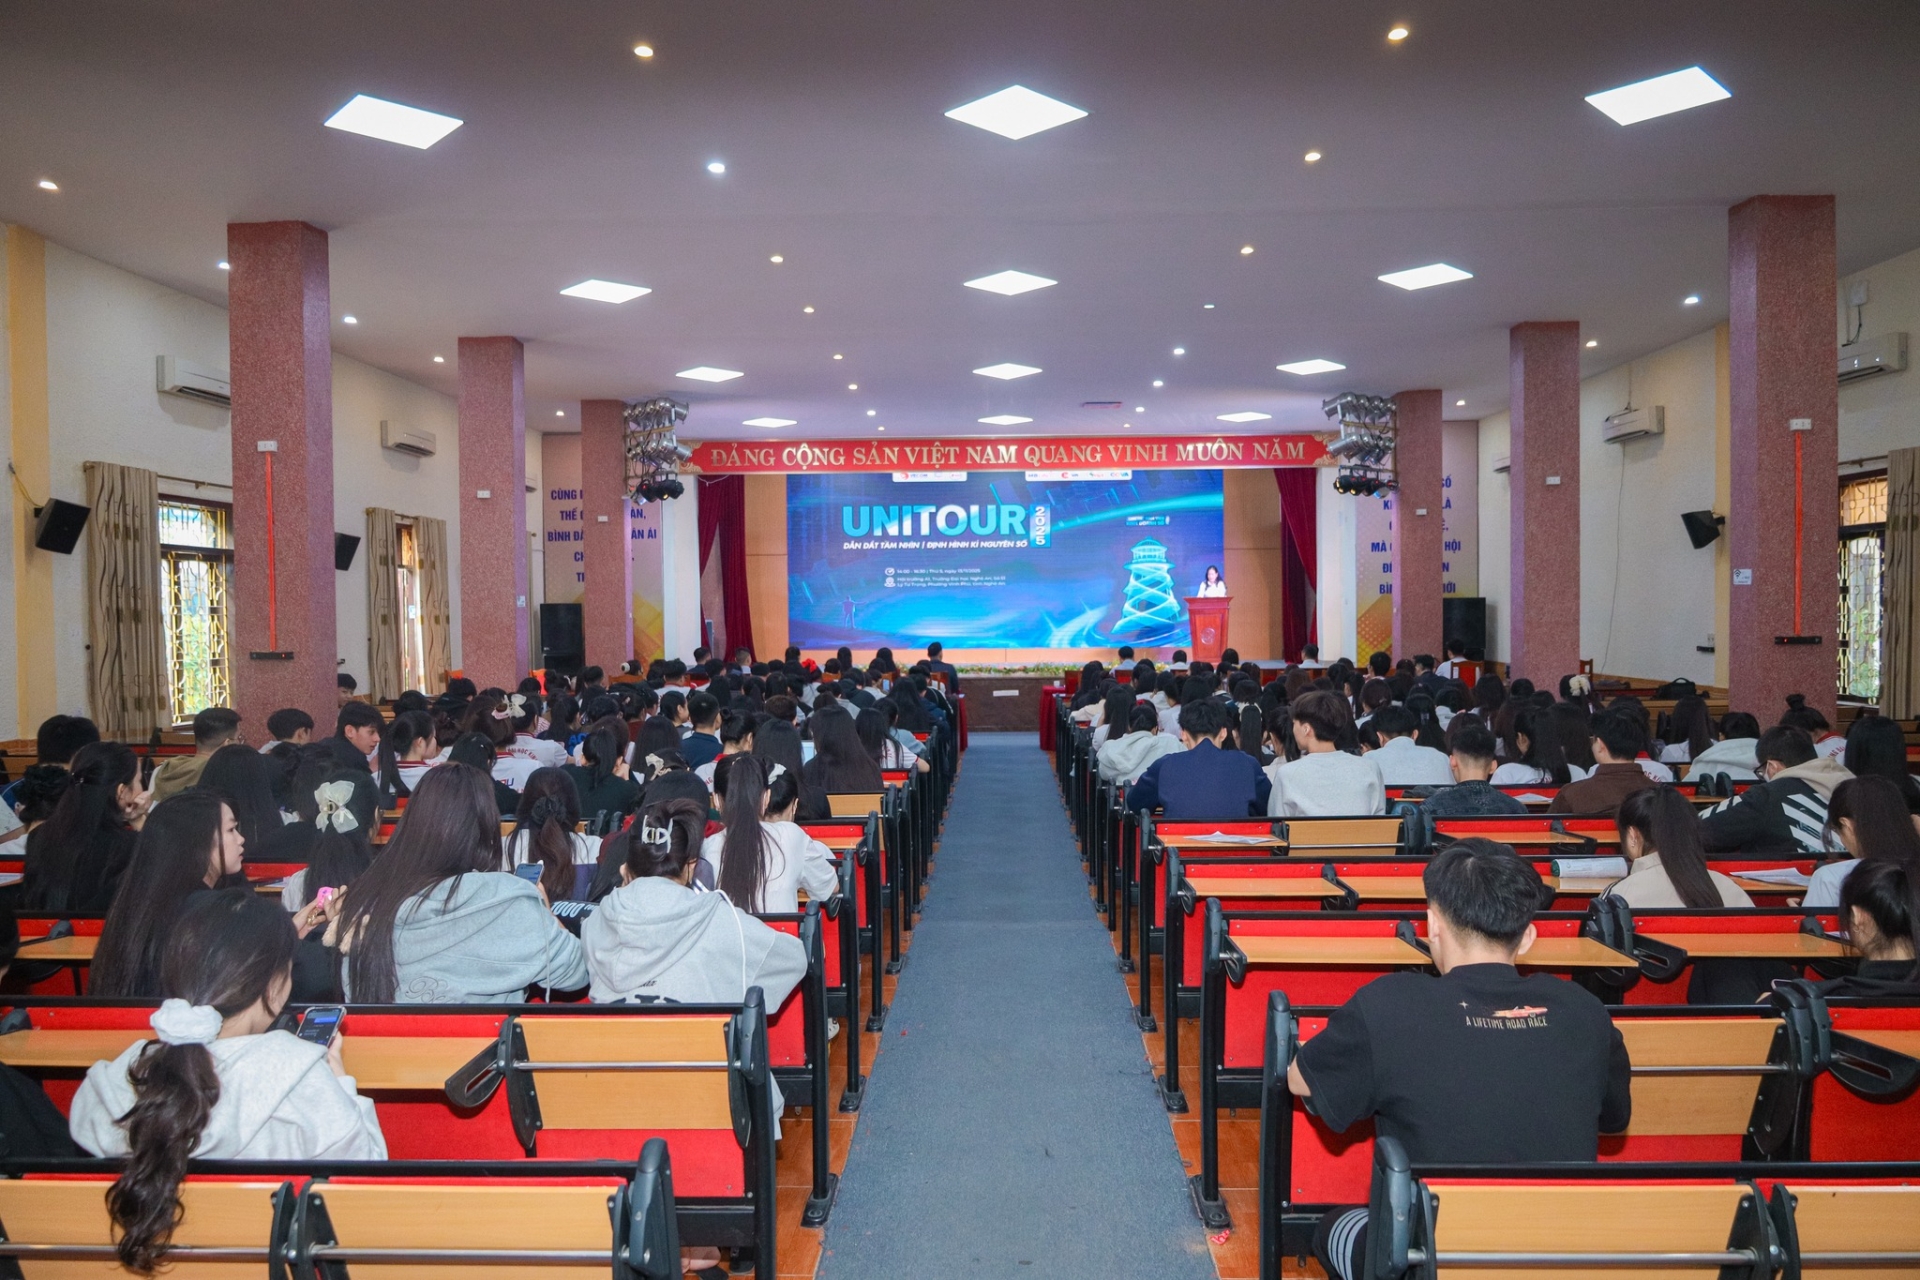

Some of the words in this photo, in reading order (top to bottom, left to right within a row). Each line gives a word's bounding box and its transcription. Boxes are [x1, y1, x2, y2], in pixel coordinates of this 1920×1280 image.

[711, 443, 776, 467] ĐẢNG
[782, 442, 846, 470] CỘNG
[852, 441, 900, 465] SẢN
[904, 441, 959, 469] VIỆT
[965, 444, 1018, 464] NAM
[1024, 444, 1103, 466] QUANG
[1108, 443, 1168, 462] VINH
[1175, 438, 1243, 461] MUÔN
[1252, 437, 1305, 460] NĂM
[551, 487, 577, 500] CÙNG
[560, 507, 577, 521] THẾ
[842, 503, 1027, 537] UNITOUR
[647, 527, 657, 539] ÁI
[1034, 506, 1046, 546] 2025
[548, 529, 571, 542] BÌNH
[1371, 539, 1387, 553] MÀ
[1445, 538, 1461, 554] HỘI
[550, 901, 586, 918] 1000
[1465, 1015, 1471, 1026] A
[1472, 1016, 1505, 1030] LIFETIME
[1505, 1018, 1527, 1030] ROAD
[1527, 1016, 1548, 1028] RACE
